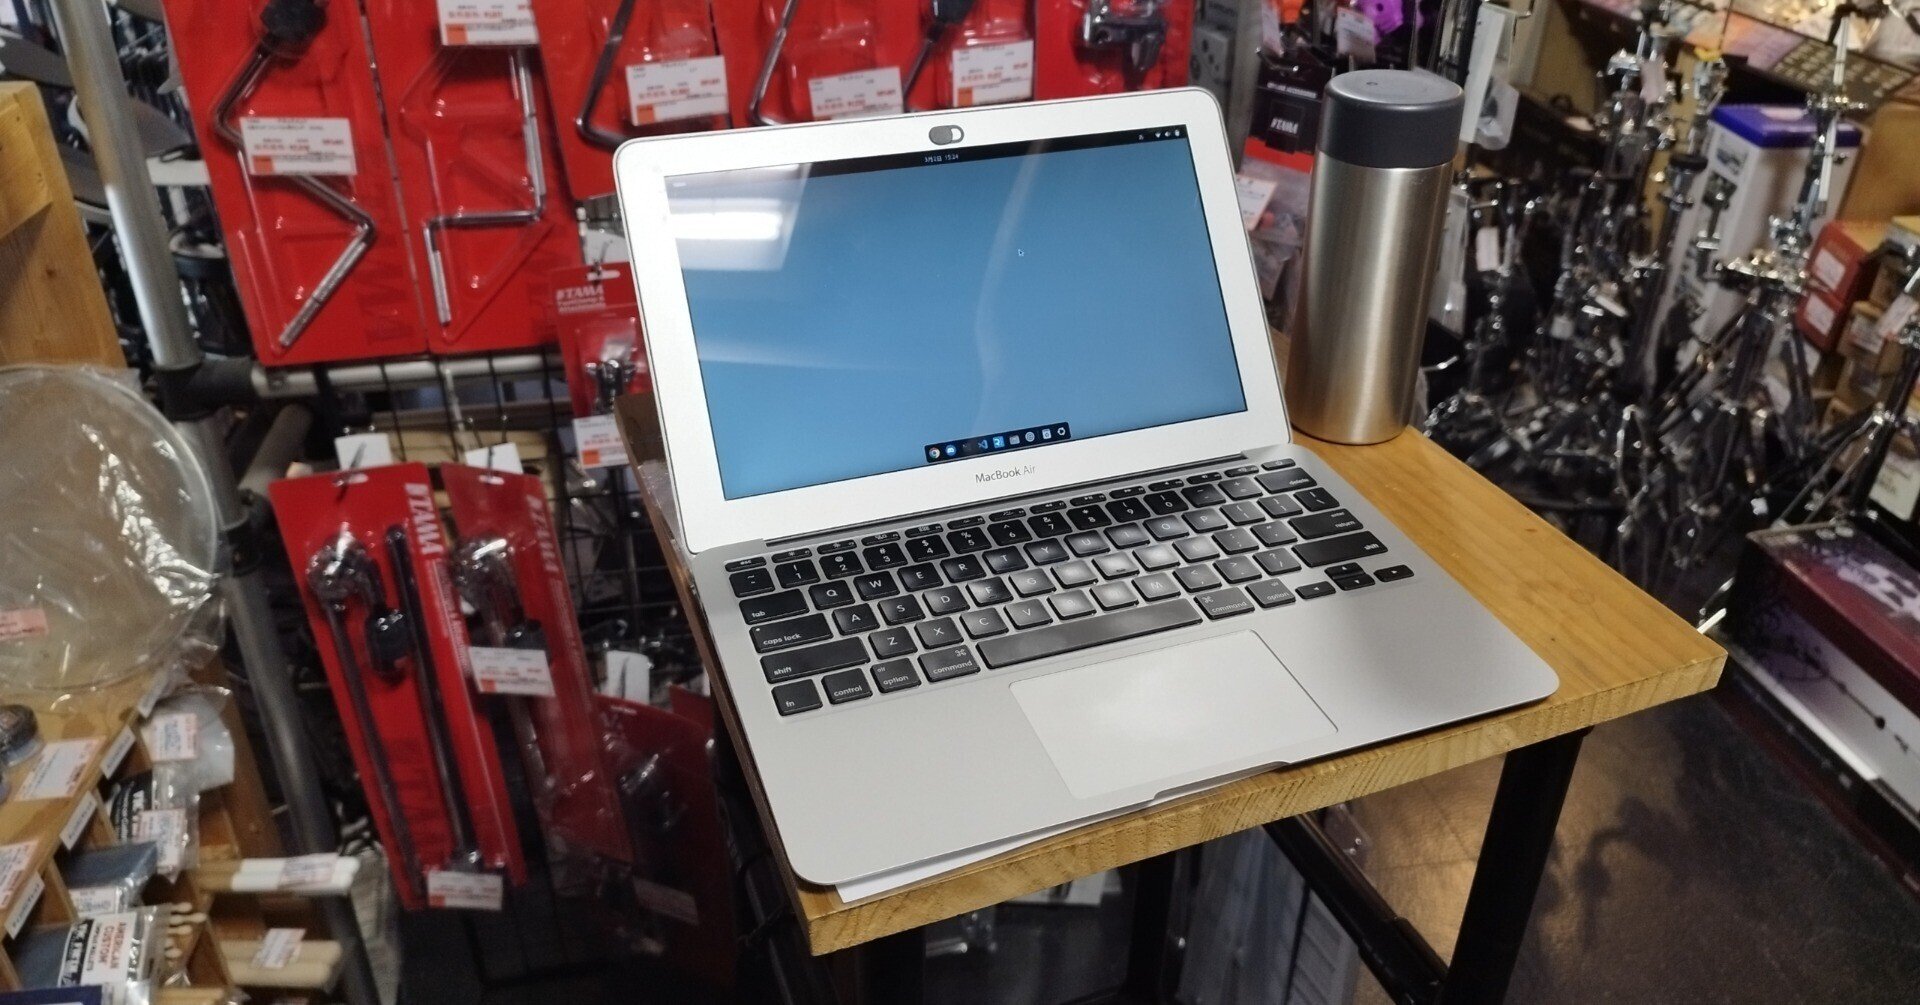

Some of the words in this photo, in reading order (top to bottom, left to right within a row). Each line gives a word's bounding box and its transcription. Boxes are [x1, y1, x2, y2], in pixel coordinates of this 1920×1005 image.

[565, 284, 604, 300] TAMA
[975, 467, 1021, 484] MacBook
[1023, 465, 1036, 477] Air
[409, 494, 445, 555] TAMA
[1081, 538, 1091, 546] U
[883, 555, 891, 563] 3
[958, 563, 968, 571] R
[795, 572, 802, 580] 1
[916, 571, 924, 579] E
[869, 580, 882, 588] W
[826, 589, 838, 597] Q
[985, 586, 992, 594] F
[940, 595, 950, 604] D
[1266, 592, 1290, 601] option
[897, 604, 905, 612] S
[1023, 608, 1031, 616] V
[1211, 602, 1247, 613] command
[751, 610, 766, 618] tab
[851, 613, 861, 622] A
[979, 617, 989, 625] C
[933, 627, 944, 637] X
[763, 637, 783, 645] caps
[784, 633, 801, 641] lock
[887, 636, 898, 646] Z
[773, 666, 792, 676] shift
[932, 660, 973, 675] command
[883, 675, 909, 687] option
[834, 685, 862, 697] control
